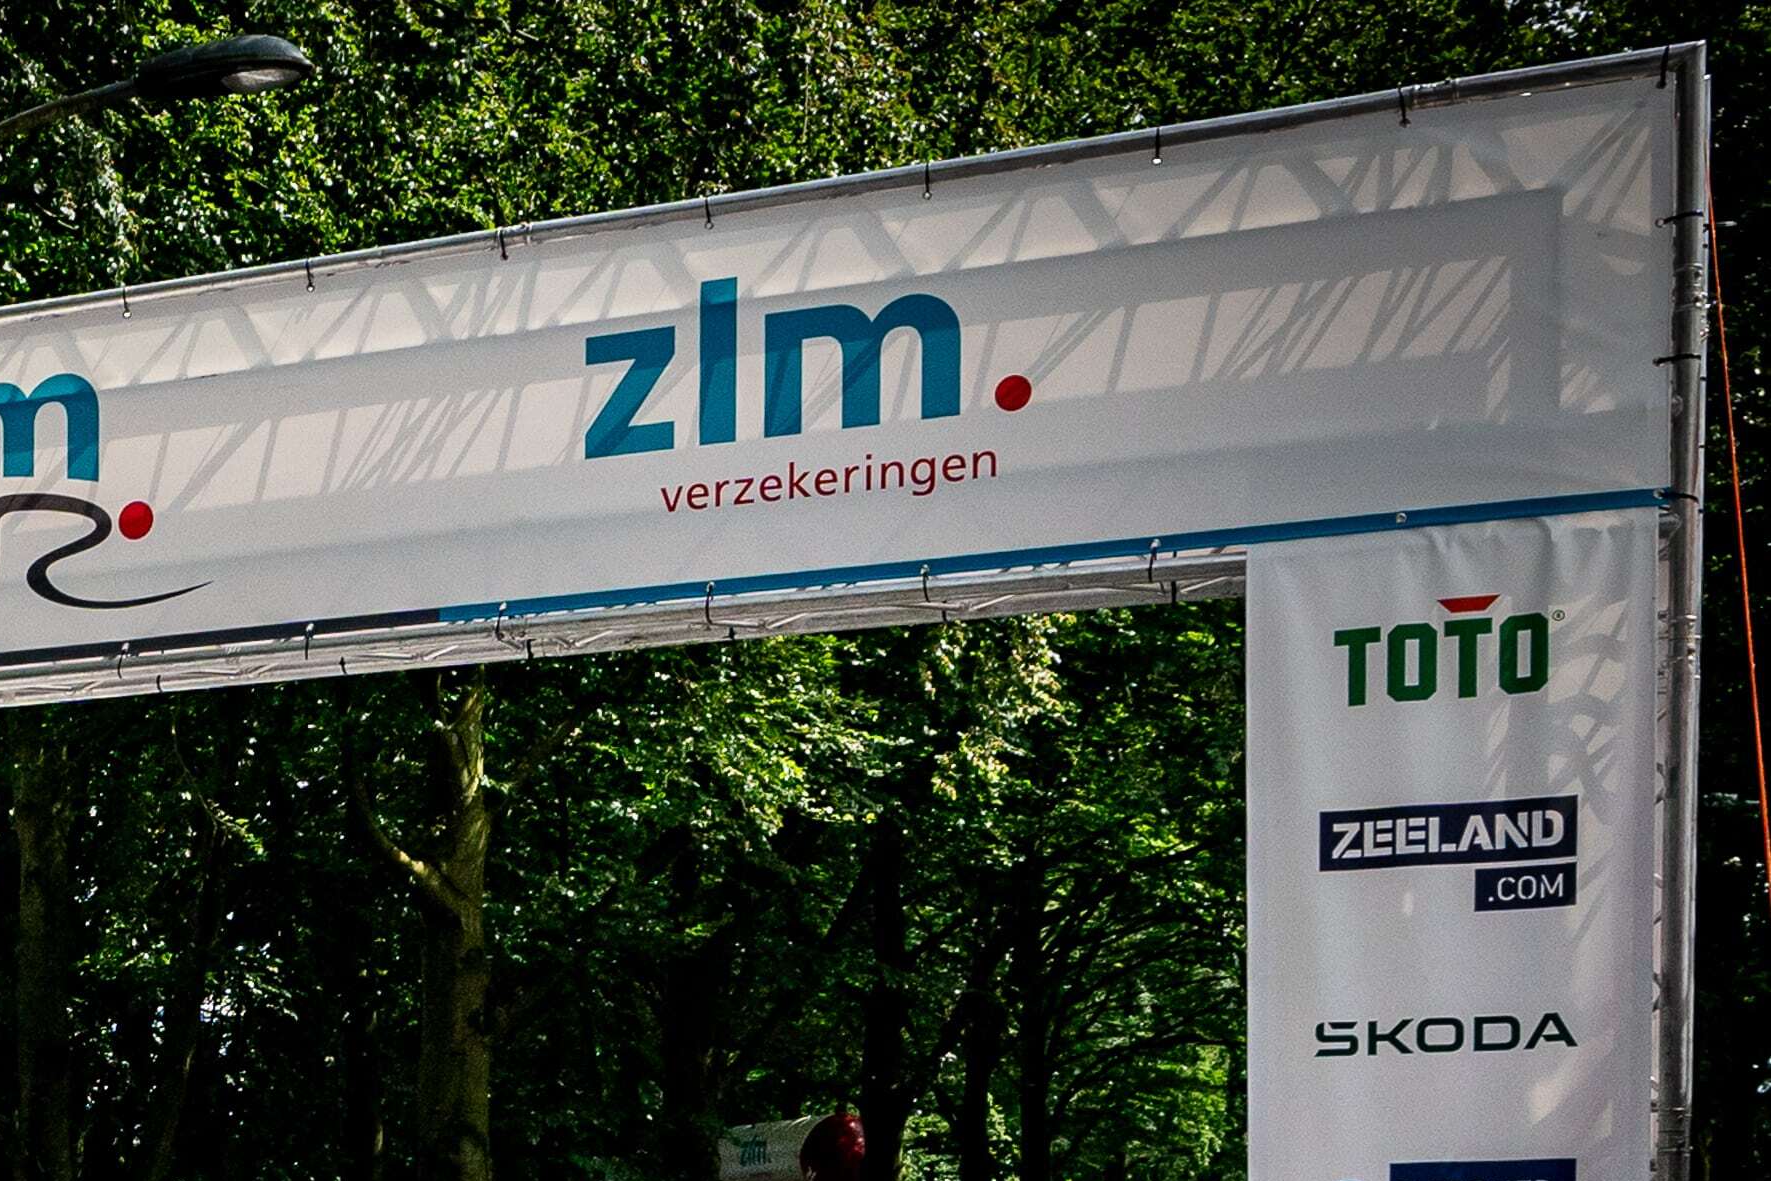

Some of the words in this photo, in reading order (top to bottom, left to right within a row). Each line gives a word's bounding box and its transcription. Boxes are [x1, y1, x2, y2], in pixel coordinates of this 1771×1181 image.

[660, 449, 998, 512] verzekeringen
[1331, 810, 1566, 860] ZEELAND
[1314, 1011, 1579, 1058] SKODA
